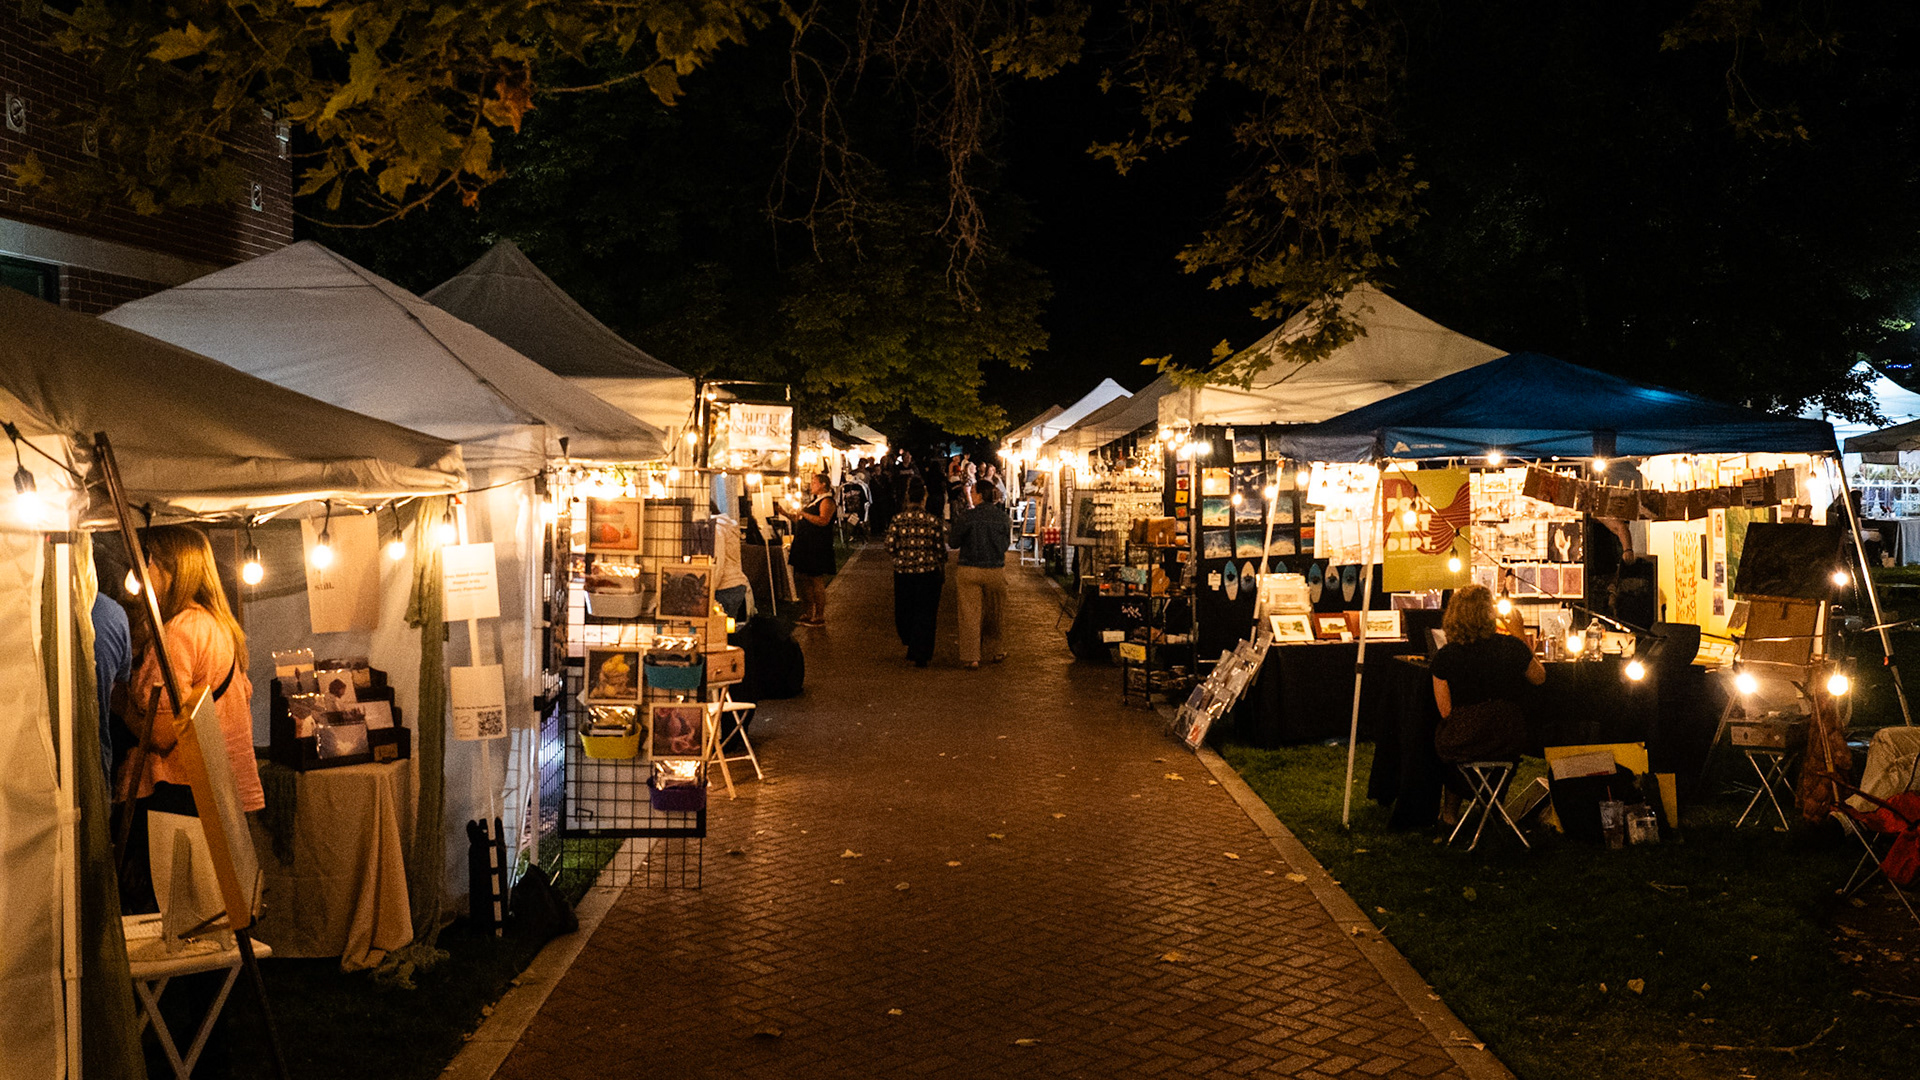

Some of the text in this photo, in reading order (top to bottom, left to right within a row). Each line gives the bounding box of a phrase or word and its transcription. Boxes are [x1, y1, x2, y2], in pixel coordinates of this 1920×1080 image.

[1386, 496, 1431, 512] POST
[1386, 513, 1432, 533] ART
[1387, 537, 1437, 552] DEPT.
